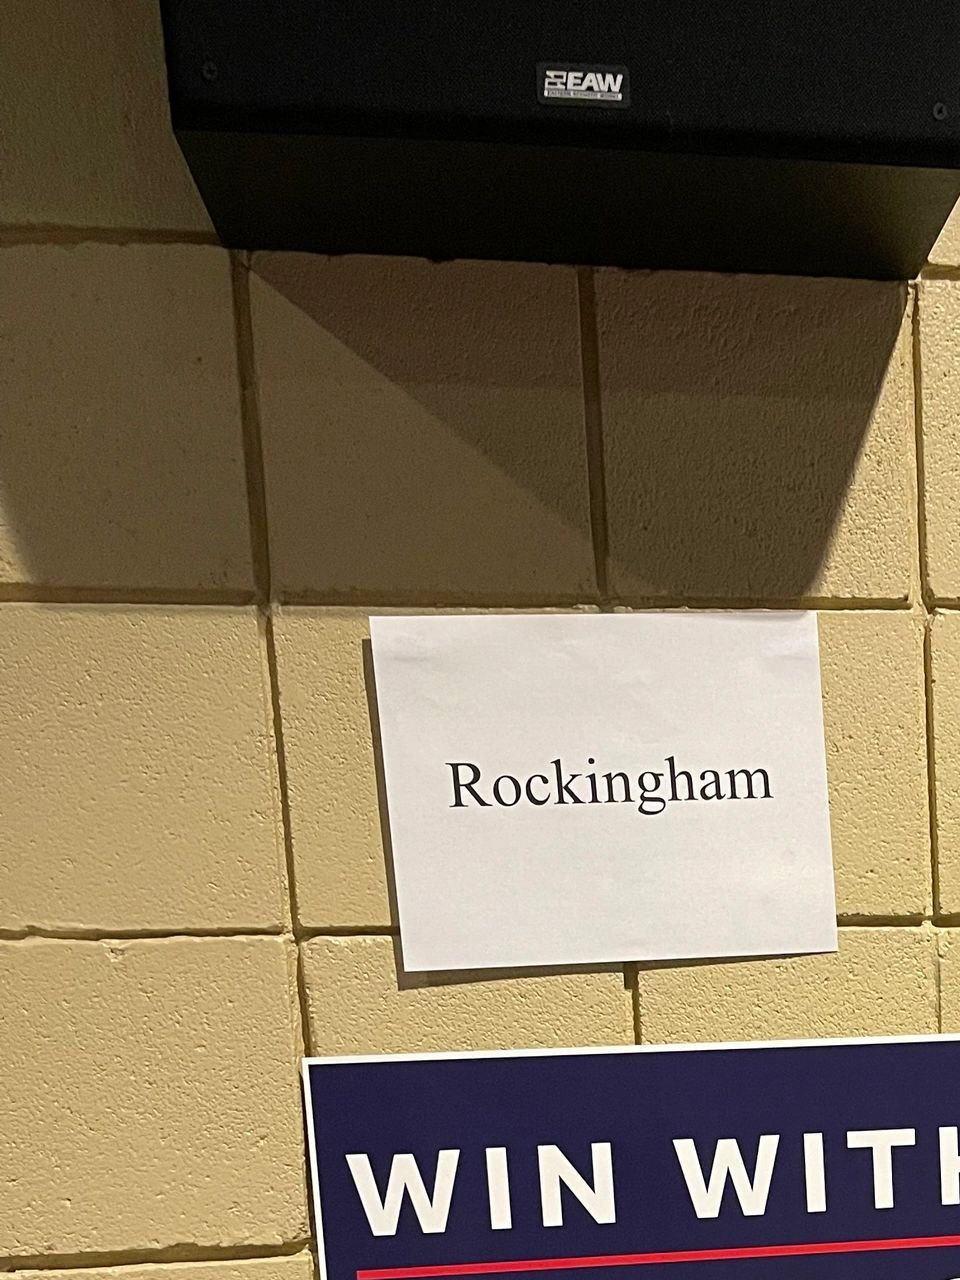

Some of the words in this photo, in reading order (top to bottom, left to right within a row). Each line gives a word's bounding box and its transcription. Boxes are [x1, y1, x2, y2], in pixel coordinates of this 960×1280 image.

[567, 71, 623, 93] EAW
[446, 756, 772, 816] Rockingham
[346, 1143, 616, 1237] WIN
